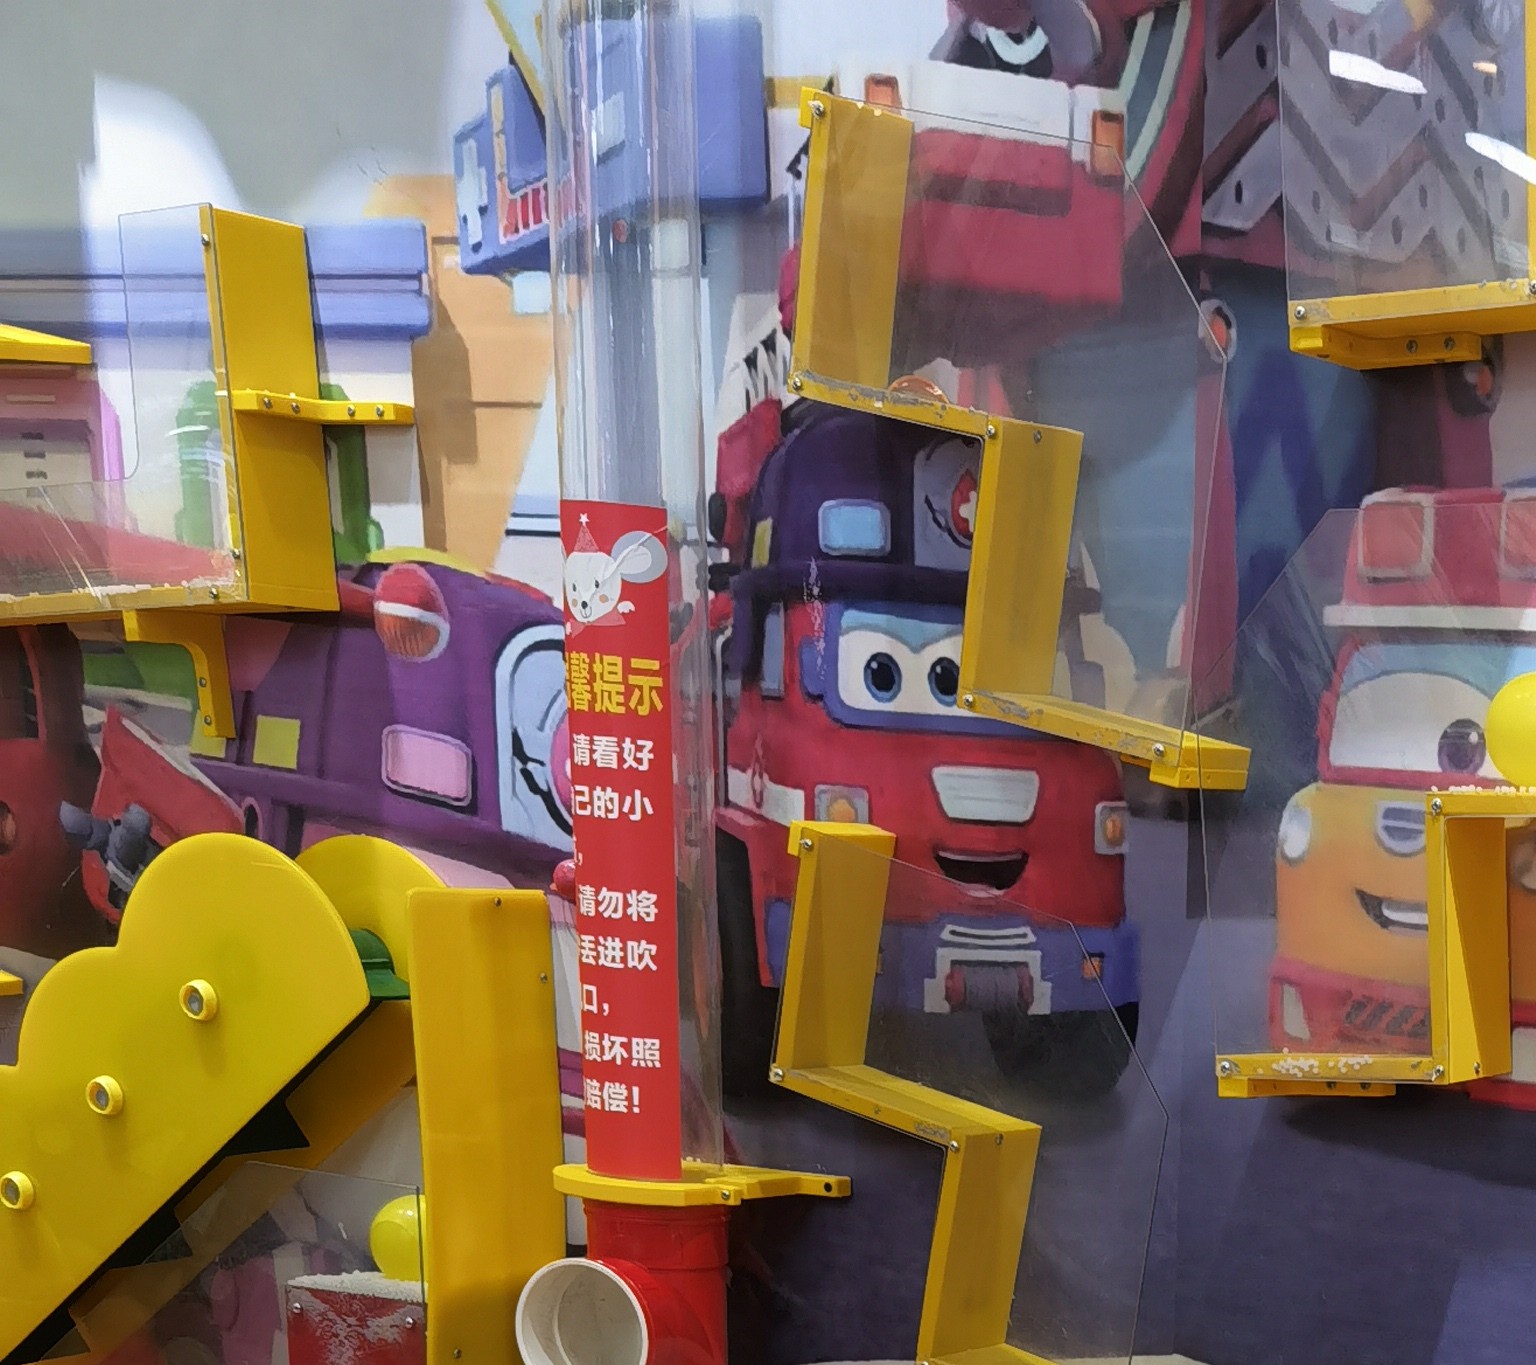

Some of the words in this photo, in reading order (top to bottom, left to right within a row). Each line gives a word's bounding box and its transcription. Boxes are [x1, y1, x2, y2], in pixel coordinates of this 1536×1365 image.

[565, 650, 664, 716] 馨提示
[573, 733, 655, 771] 请看好
[571, 785, 654, 821] 己的小
[578, 884, 659, 922] 请勿将
[580, 934, 658, 971] 丢进吹
[584, 1030, 661, 1068] 损坏照
[583, 1078, 640, 1114] 赔偿！
